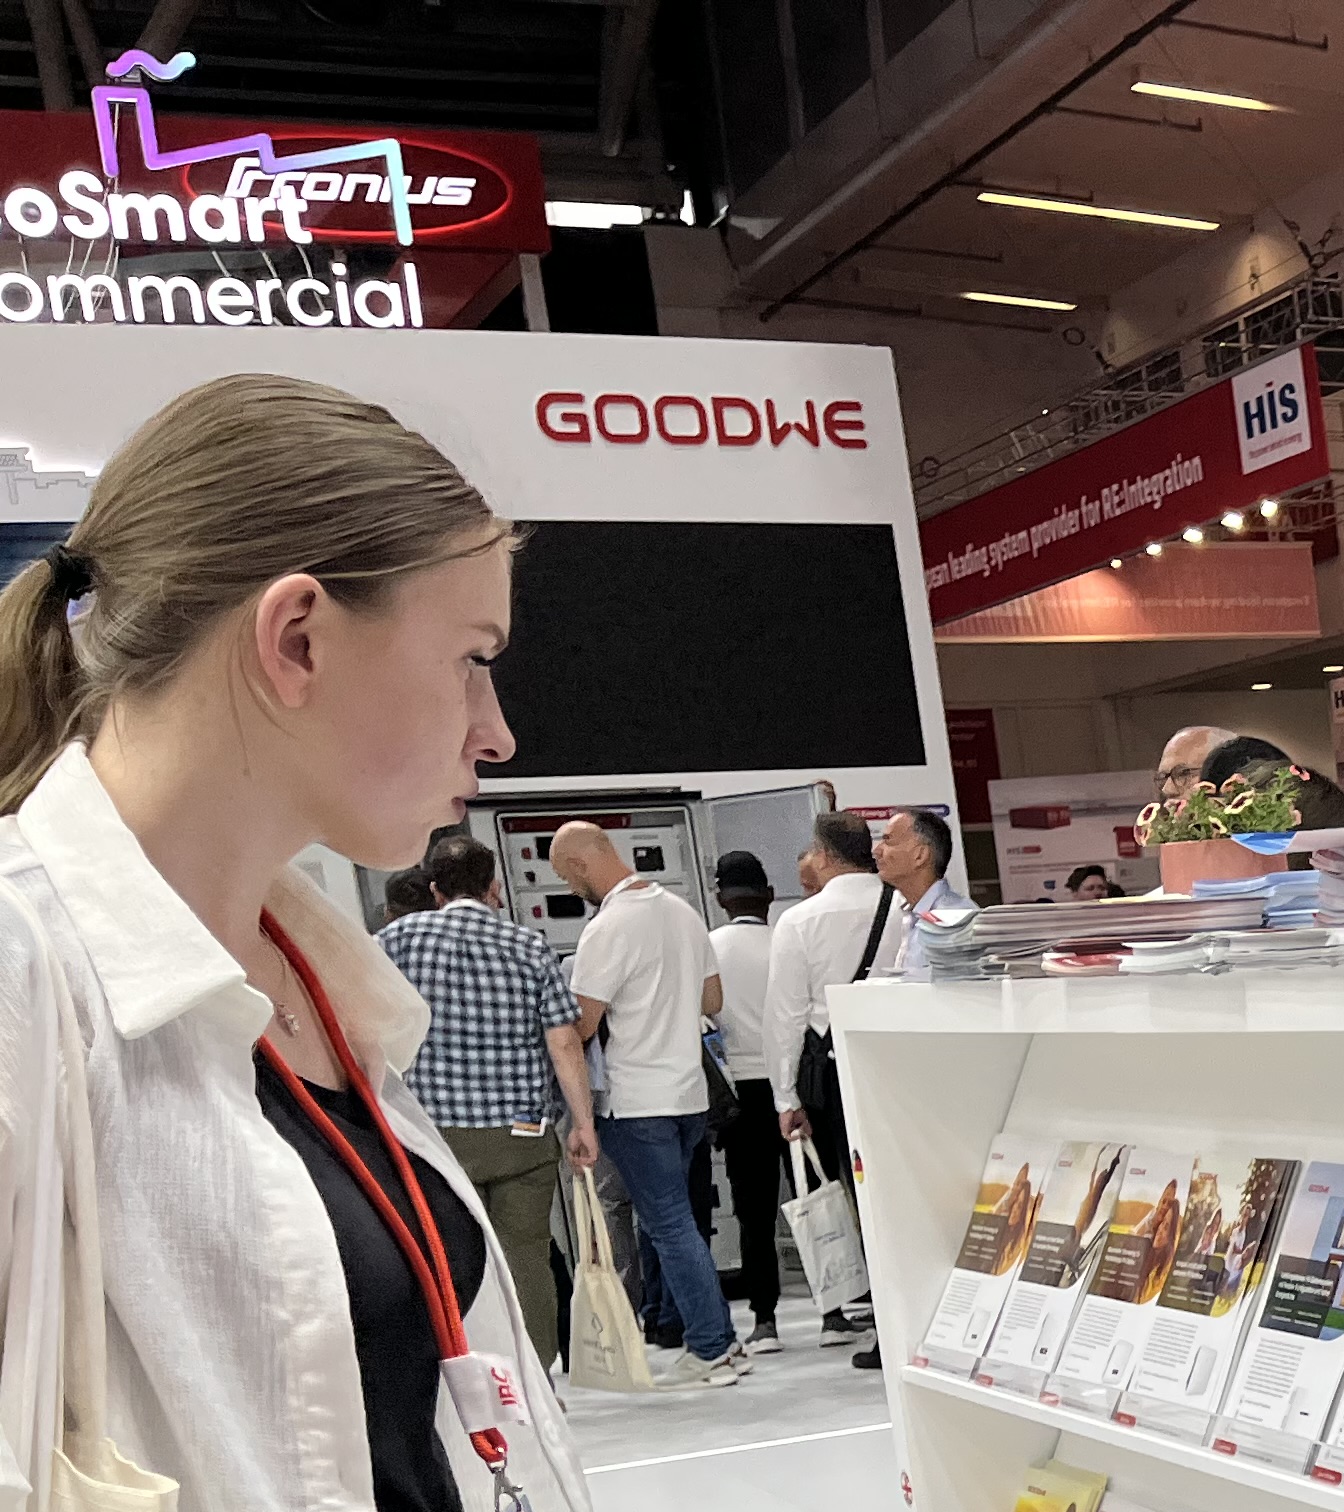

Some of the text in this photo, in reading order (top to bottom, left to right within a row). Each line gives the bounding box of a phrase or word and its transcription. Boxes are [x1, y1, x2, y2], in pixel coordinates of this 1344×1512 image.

[0, 169, 313, 244] oSmart
[536, 392, 868, 450] GOODWE
[1080, 495, 1101, 529] for
